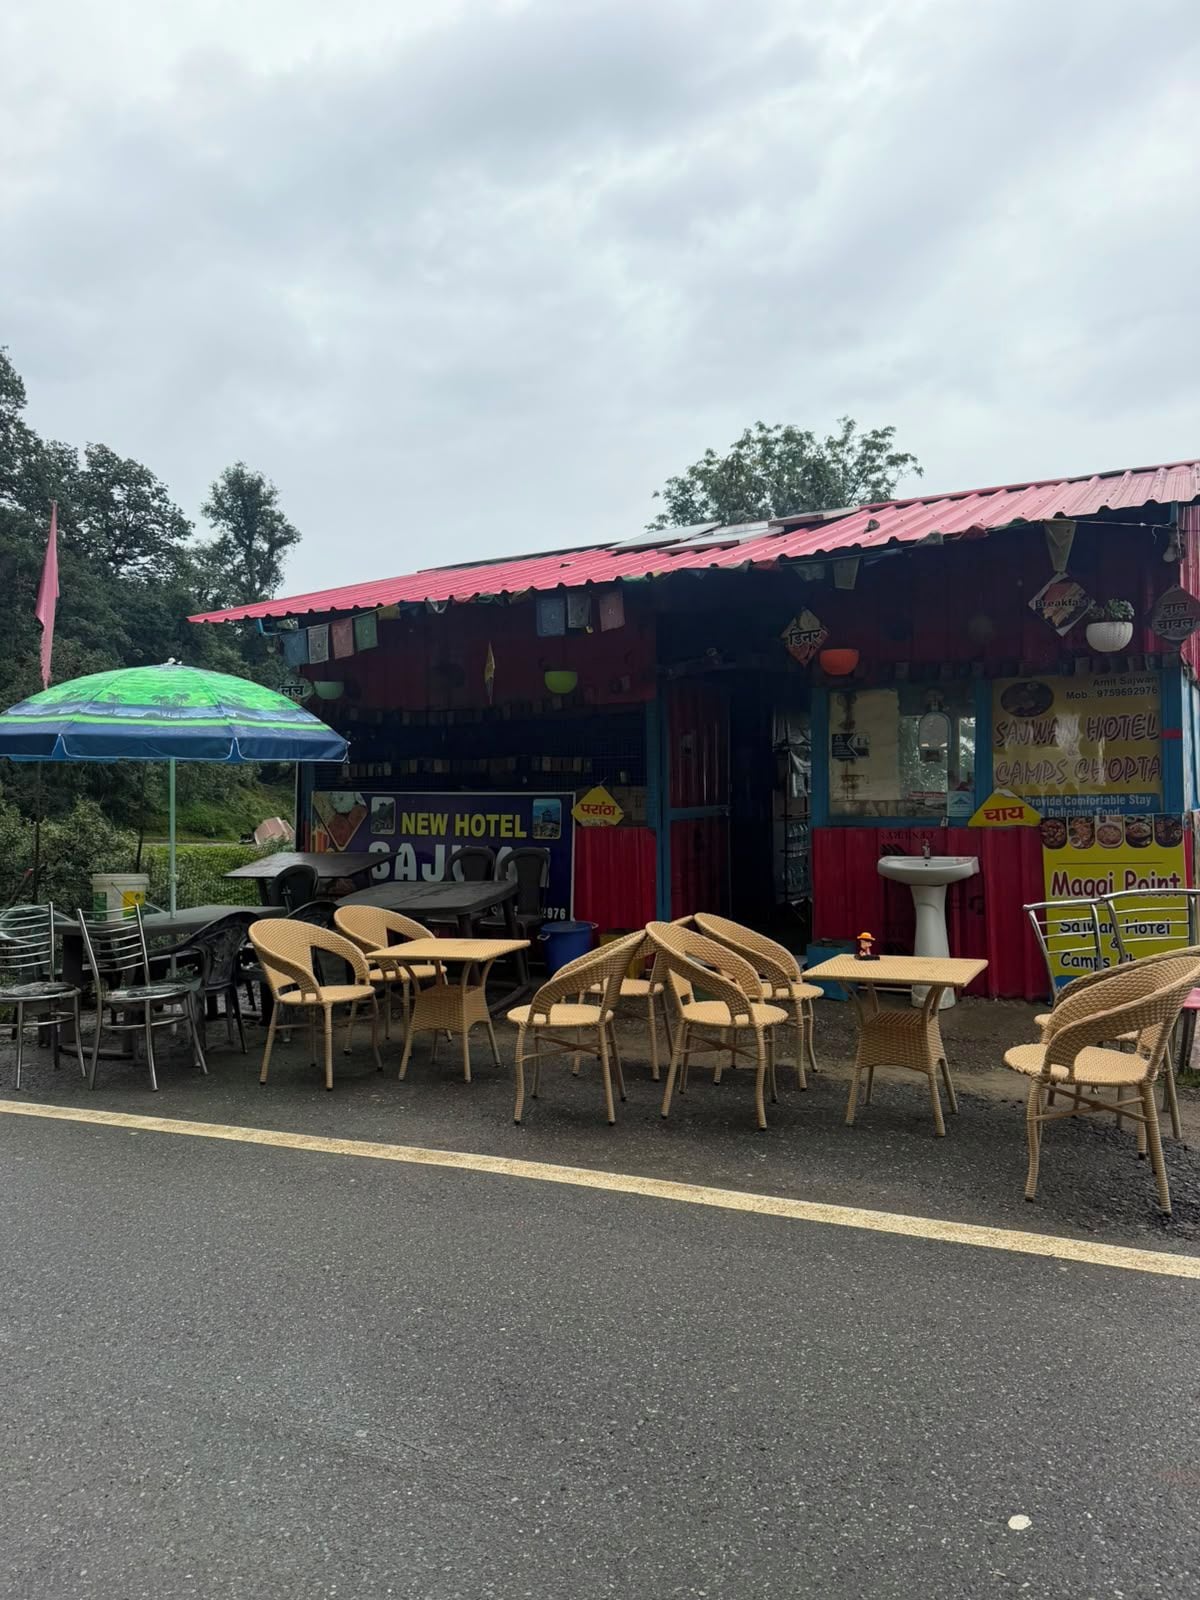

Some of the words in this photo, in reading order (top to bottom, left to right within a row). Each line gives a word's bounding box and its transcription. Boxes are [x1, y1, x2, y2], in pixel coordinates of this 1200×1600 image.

[1157, 617, 1194, 630] चावल
[789, 628, 821, 645] डिनर
[280, 681, 305, 696] लंच
[1093, 677, 1117, 688] Amit
[1119, 674, 1158, 687] Sajwan
[994, 716, 1079, 748] SAJWAN
[1086, 713, 1160, 743] HOTEL
[995, 758, 1068, 786] CAMPS
[1074, 754, 1162, 784] CHOPTA
[580, 801, 617, 816] परांठा
[1025, 796, 1062, 807] Provide
[1064, 795, 1126, 807] Comfortable
[1128, 794, 1152, 807] Stay
[983, 805, 1025, 822] चाय
[1048, 807, 1094, 818] Delicious
[400, 811, 449, 837] NEW
[453, 812, 528, 839] HOTEL
[1124, 869, 1182, 897] Point
[1125, 918, 1171, 935] Hotel
